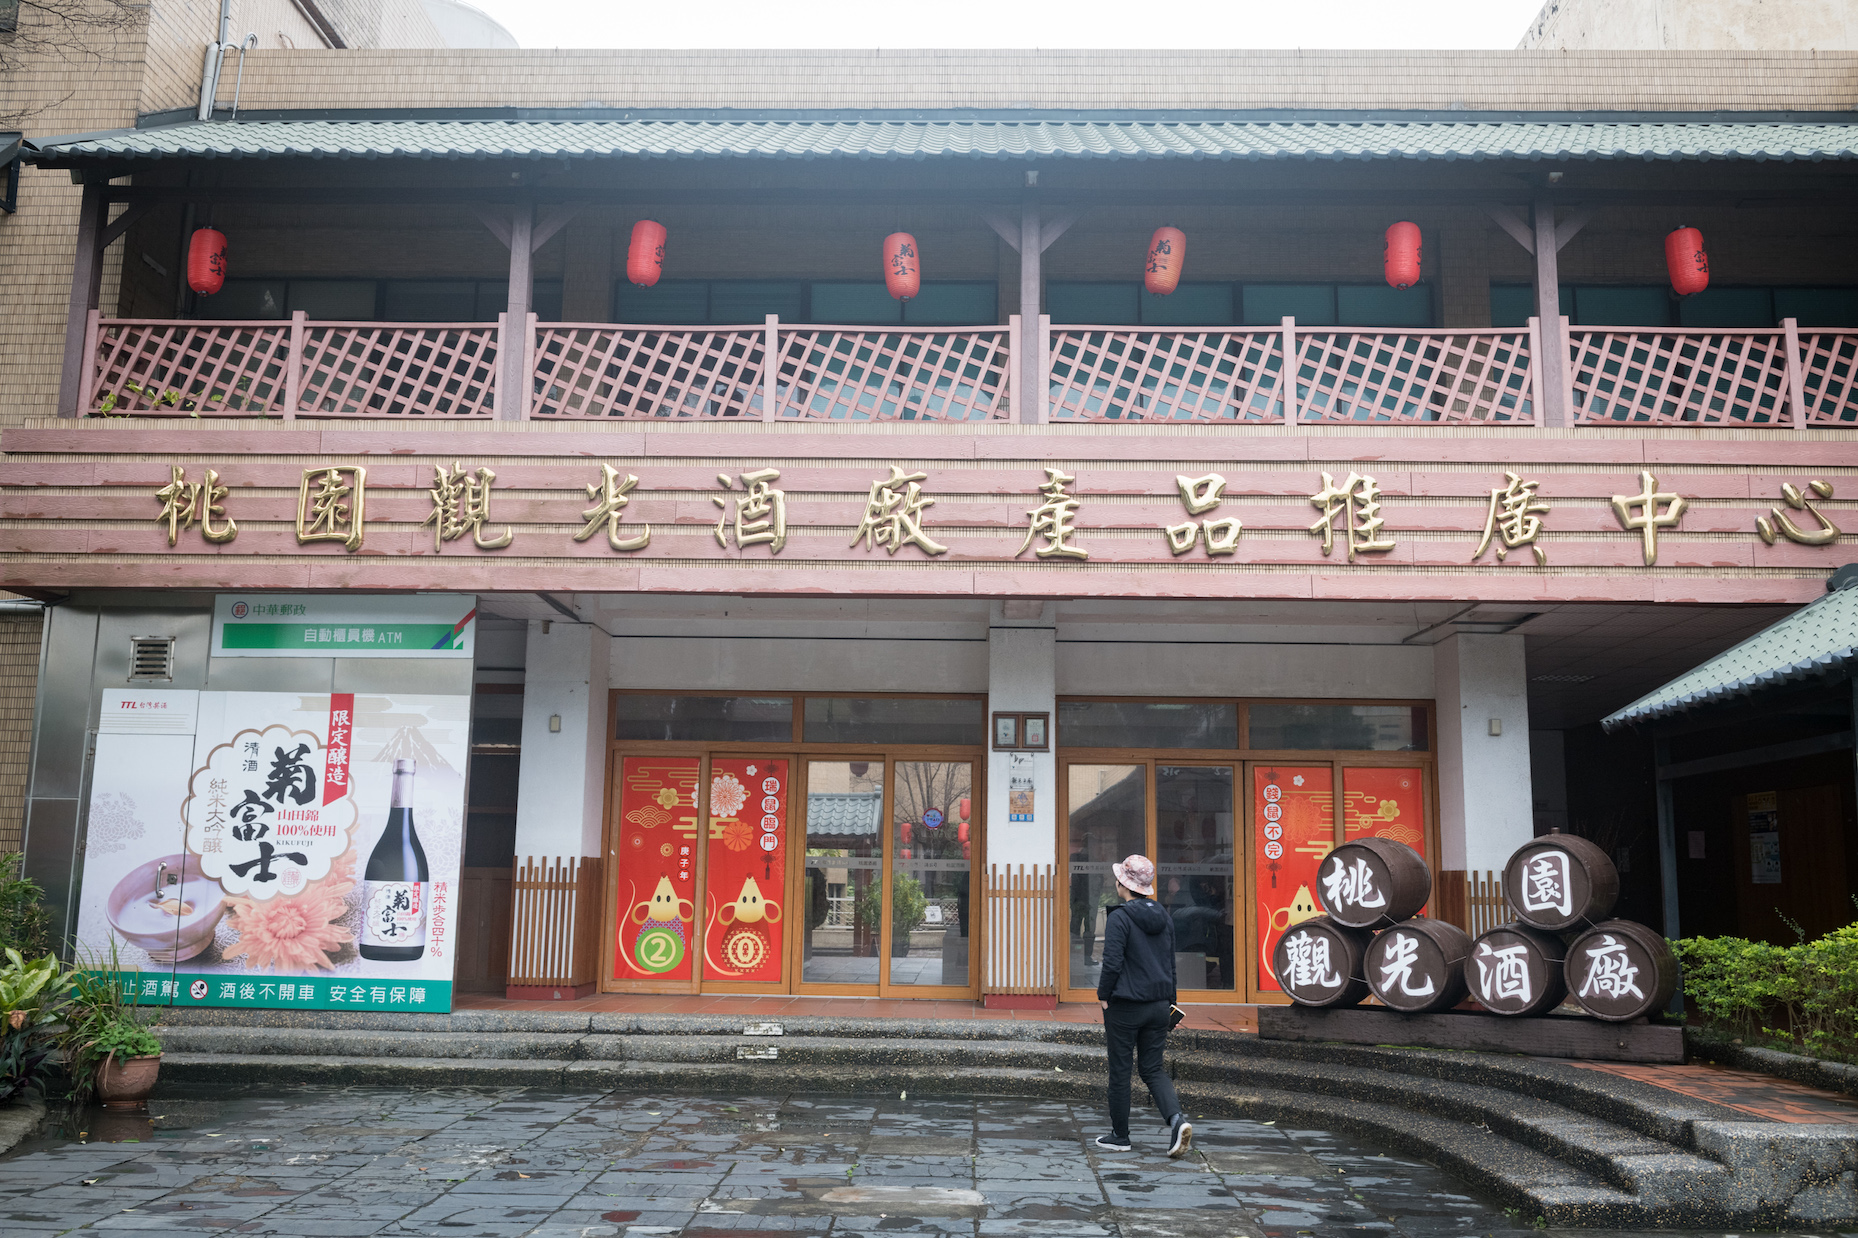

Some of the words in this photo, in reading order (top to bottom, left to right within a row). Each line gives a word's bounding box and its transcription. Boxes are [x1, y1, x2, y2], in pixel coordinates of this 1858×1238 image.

[892, 244, 915, 279] 菊富士
[154, 461, 1842, 567] 桃園觀光酒廠產品推廣中心
[252, 604, 307, 616] 中華郵政
[303, 628, 375, 643] 自動櫃員機
[377, 632, 402, 644] ATM
[120, 701, 138, 709] TTL
[242, 742, 260, 772] 清酒
[229, 743, 317, 883] 菊富士
[276, 824, 336, 837] 100%使用
[277, 809, 320, 822] 山田錦
[763, 780, 778, 849] 瑞鼠臨門
[1265, 787, 1280, 857] 錢鼠不完
[680, 846, 690, 880] 庚子年
[1322, 856, 1386, 913] 桃
[1521, 850, 1574, 918] 園
[381, 889, 410, 937] 菊富士
[650, 937, 667, 962] 2
[737, 938, 754, 963] 0
[1283, 930, 1341, 990] 觀
[1380, 933, 1435, 997] 光
[1579, 935, 1644, 1000] 廠
[103, 978, 180, 998] 止酒駕
[219, 982, 316, 1001] 酒後不開車
[329, 985, 427, 1005] 安全有保障
[1480, 943, 1533, 1001] 酒
